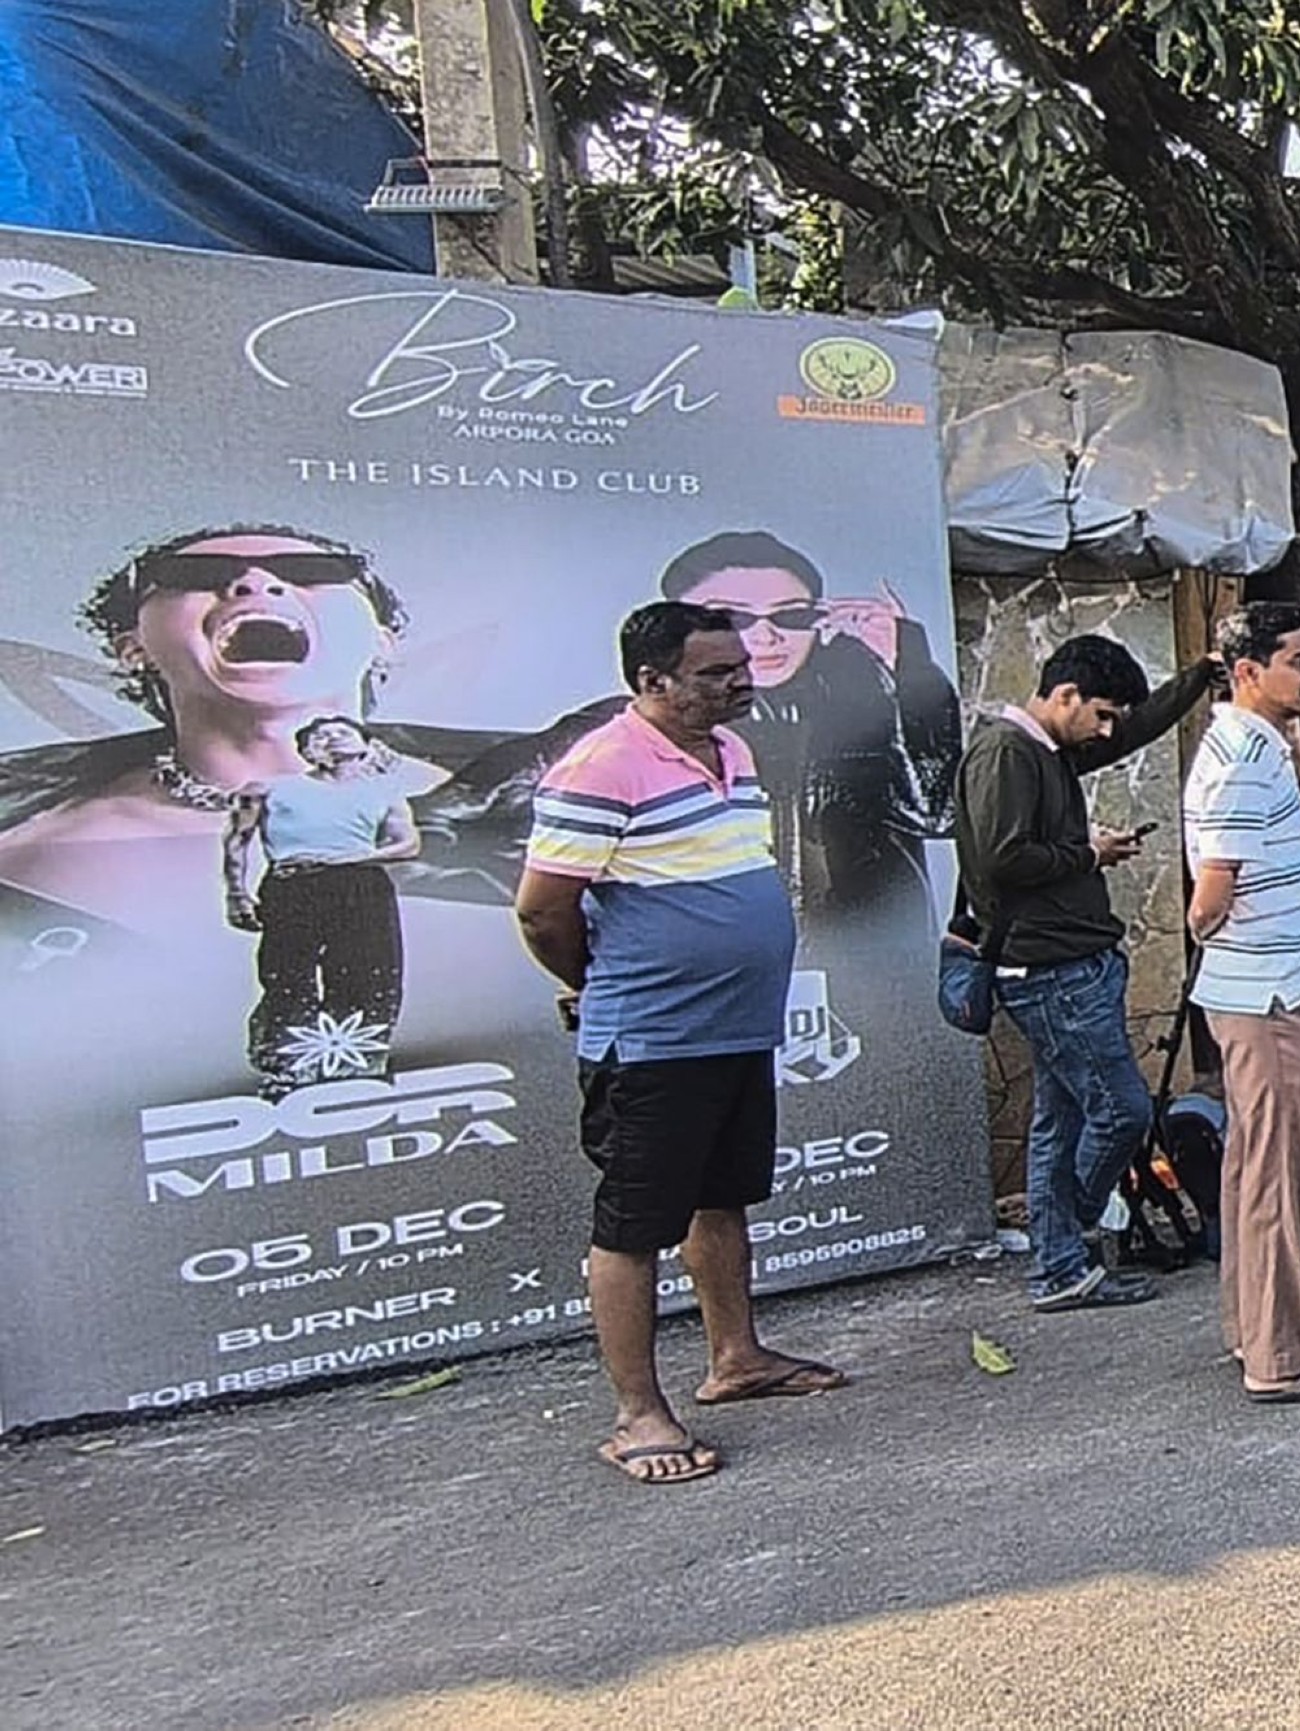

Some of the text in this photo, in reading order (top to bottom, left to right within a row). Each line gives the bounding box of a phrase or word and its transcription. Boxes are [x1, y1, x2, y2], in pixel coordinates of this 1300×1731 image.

[245, 289, 719, 418] Birch
[437, 404, 628, 428] By Romeo Lane
[565, 428, 616, 445] GOA
[288, 458, 700, 494] THE ISLAND CLUB
[145, 1119, 518, 1203] MILDA
[811, 1171, 836, 1186] 10
[839, 1164, 877, 1180] PM
[180, 1200, 505, 1283] 05 DEC
[237, 1264, 350, 1298] FRIDAY
[377, 1253, 410, 1270] 10
[416, 1243, 464, 1263] PM
[217, 1286, 458, 1353] BURNER
[747, 1206, 864, 1243] SOUL
[127, 1380, 208, 1411] FOR
[218, 1320, 485, 1394] RESERVATIONS
[505, 1304, 556, 1326] +91
